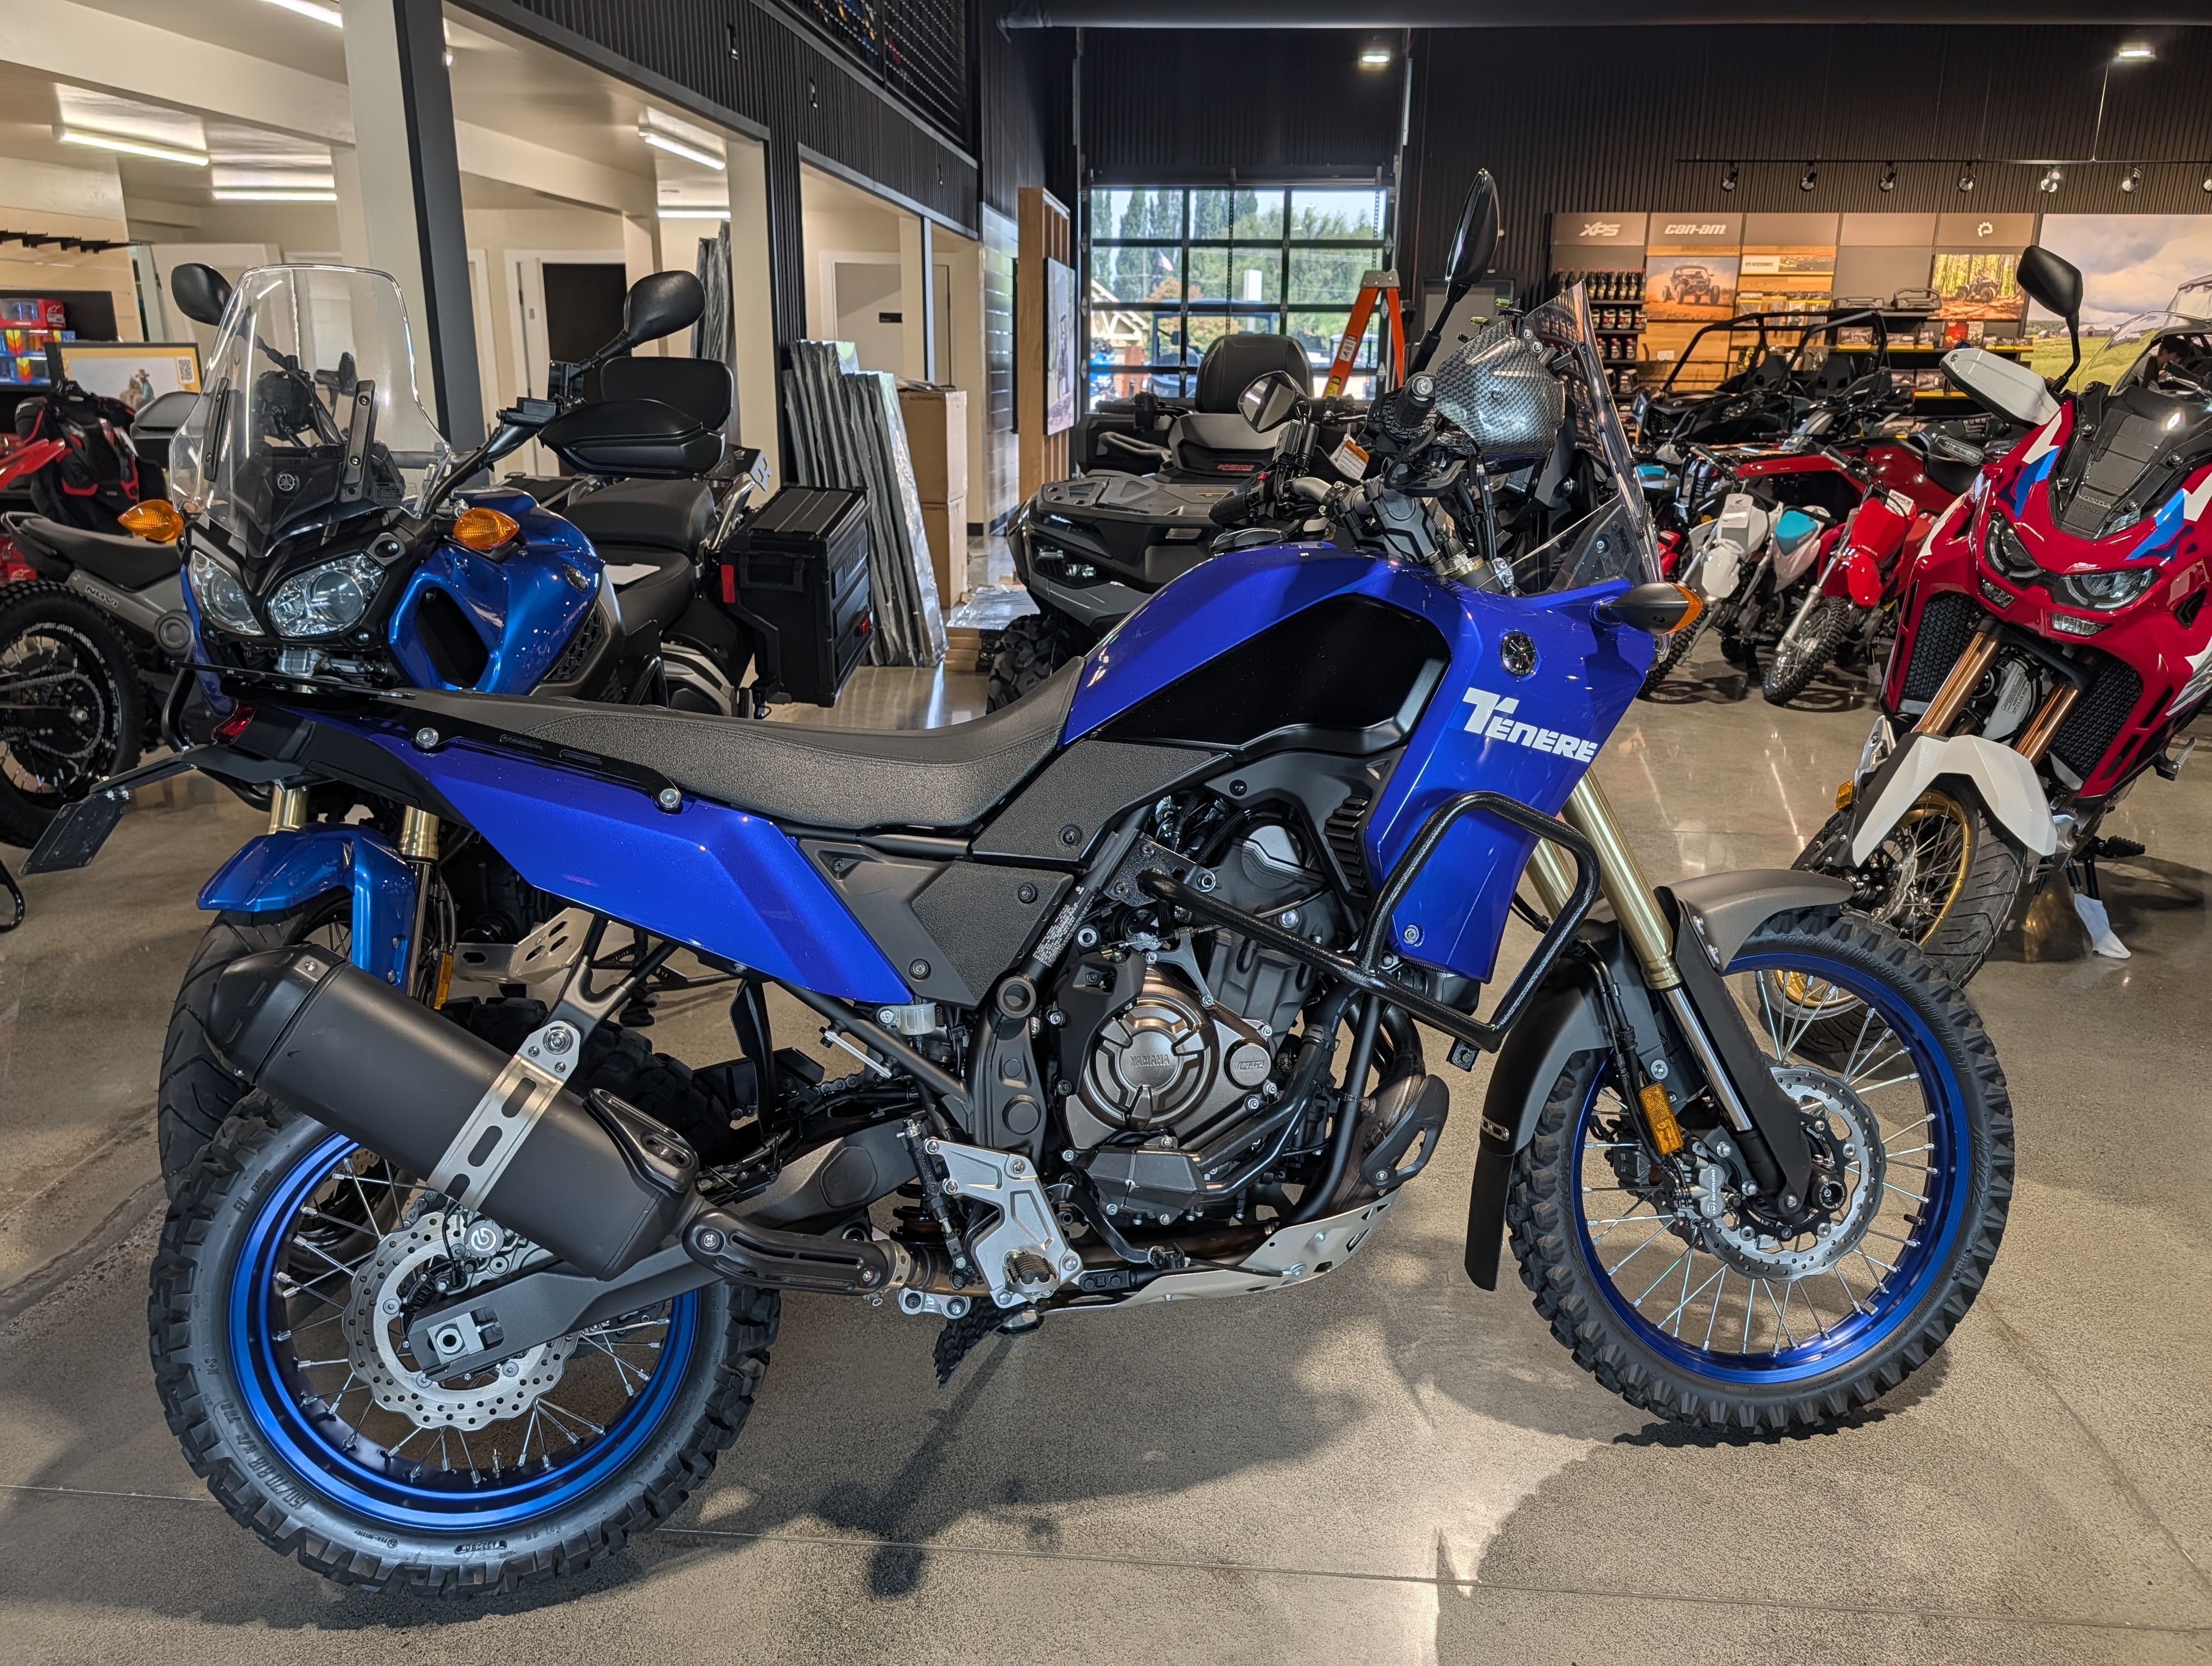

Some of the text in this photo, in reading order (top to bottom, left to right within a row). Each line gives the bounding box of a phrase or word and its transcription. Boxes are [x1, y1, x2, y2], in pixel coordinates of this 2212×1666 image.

[1579, 221, 1621, 237] XPS
[1664, 223, 1727, 235] can-am
[85, 584, 119, 608] NAVI
[1129, 1055, 1170, 1067] YAMAHA
[1237, 1060, 1265, 1071] CP2
[250, 1168, 272, 1194] ENDURO
[205, 1357, 220, 1376] M+S
[264, 1471, 312, 1512] 150/70
